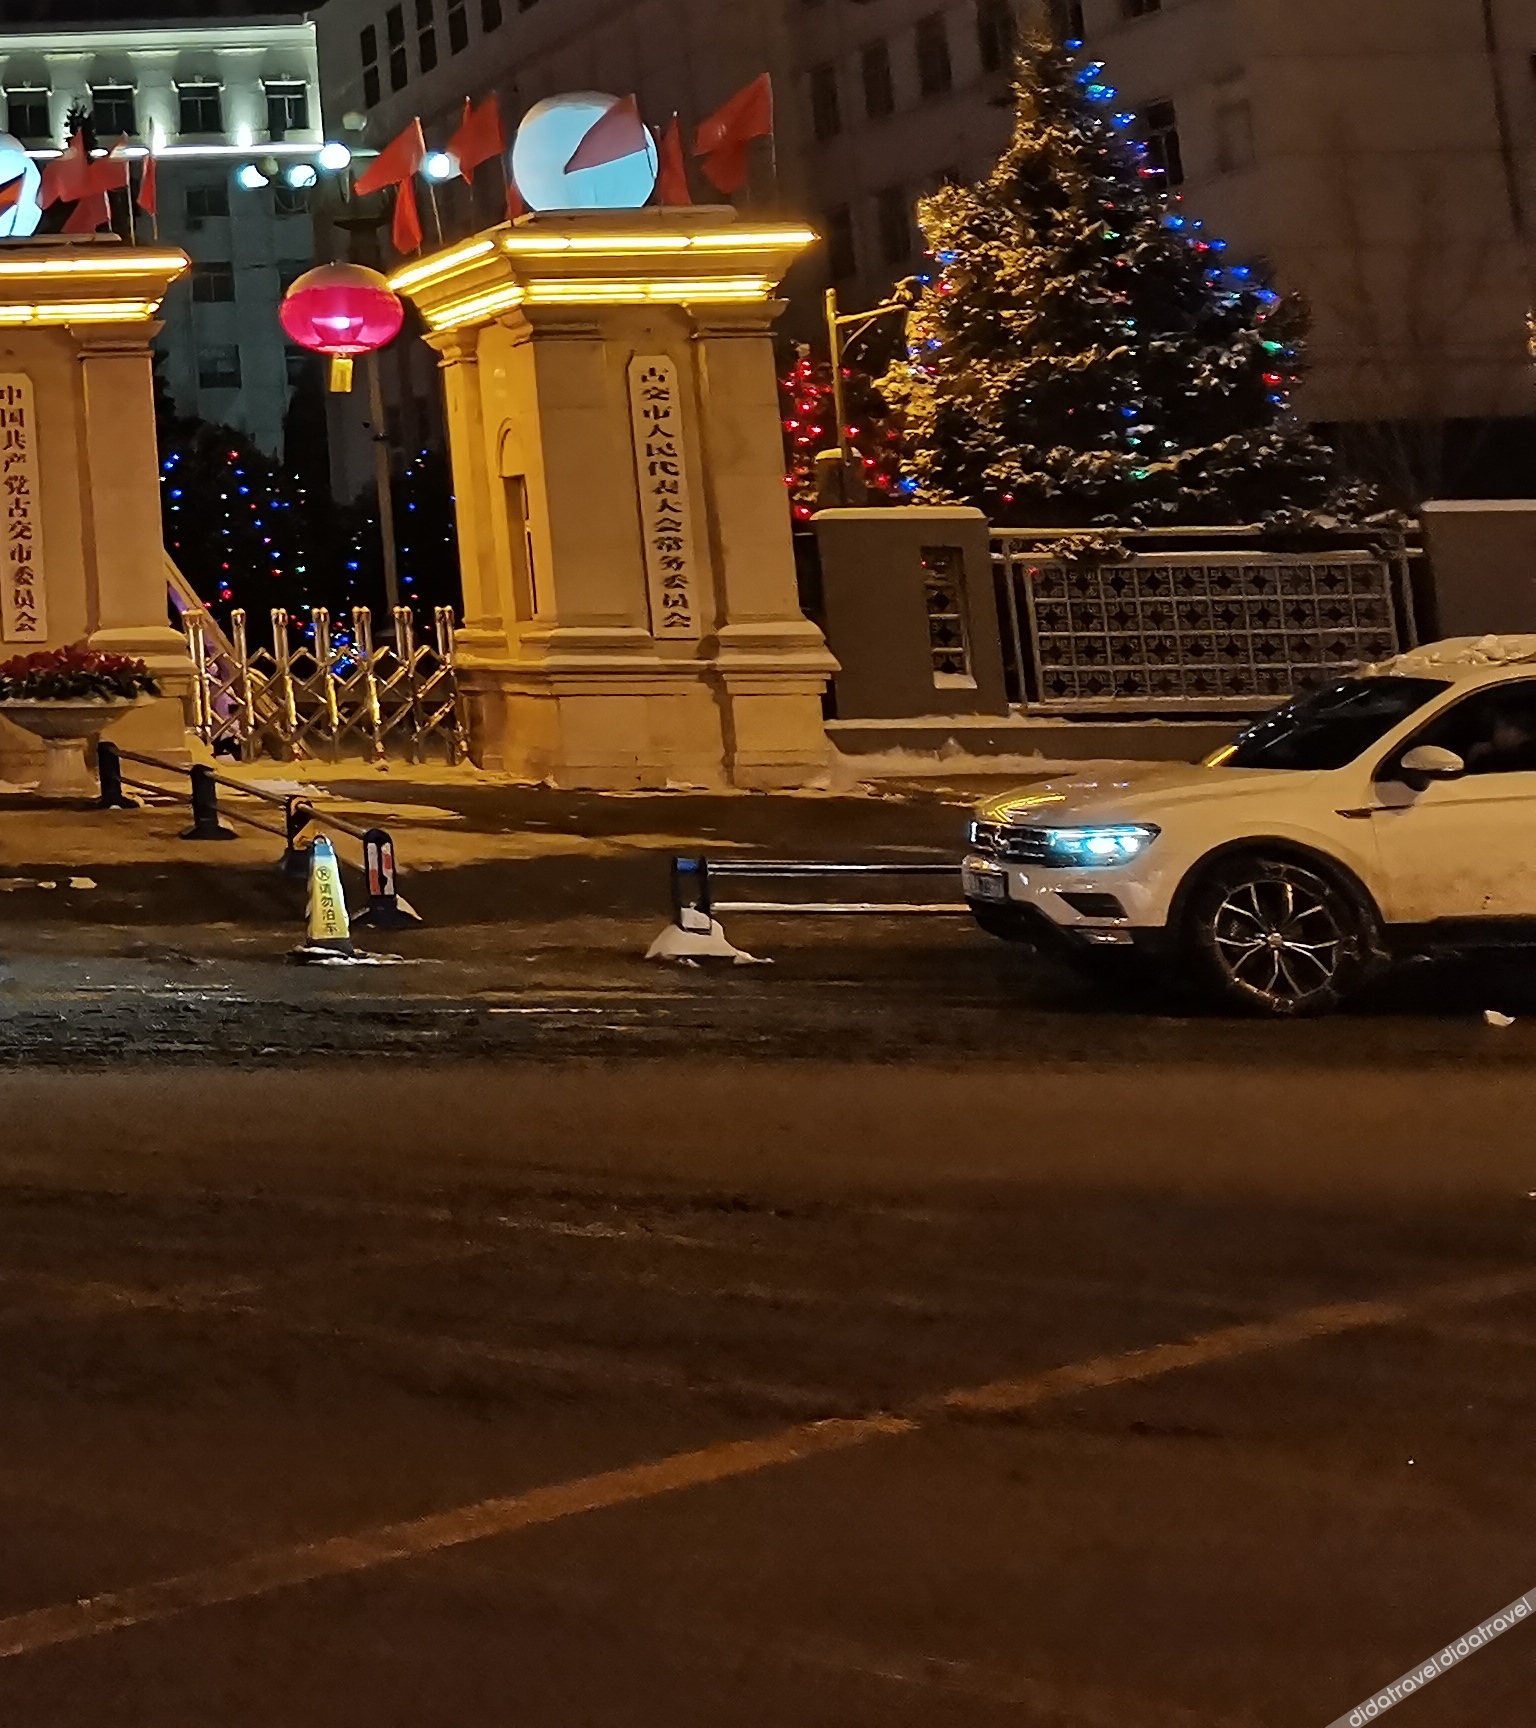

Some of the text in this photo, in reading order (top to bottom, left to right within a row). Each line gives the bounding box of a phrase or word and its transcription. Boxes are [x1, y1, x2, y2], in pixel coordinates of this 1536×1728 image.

[641, 366, 692, 629] 古交市人民代表大会常务委员会
